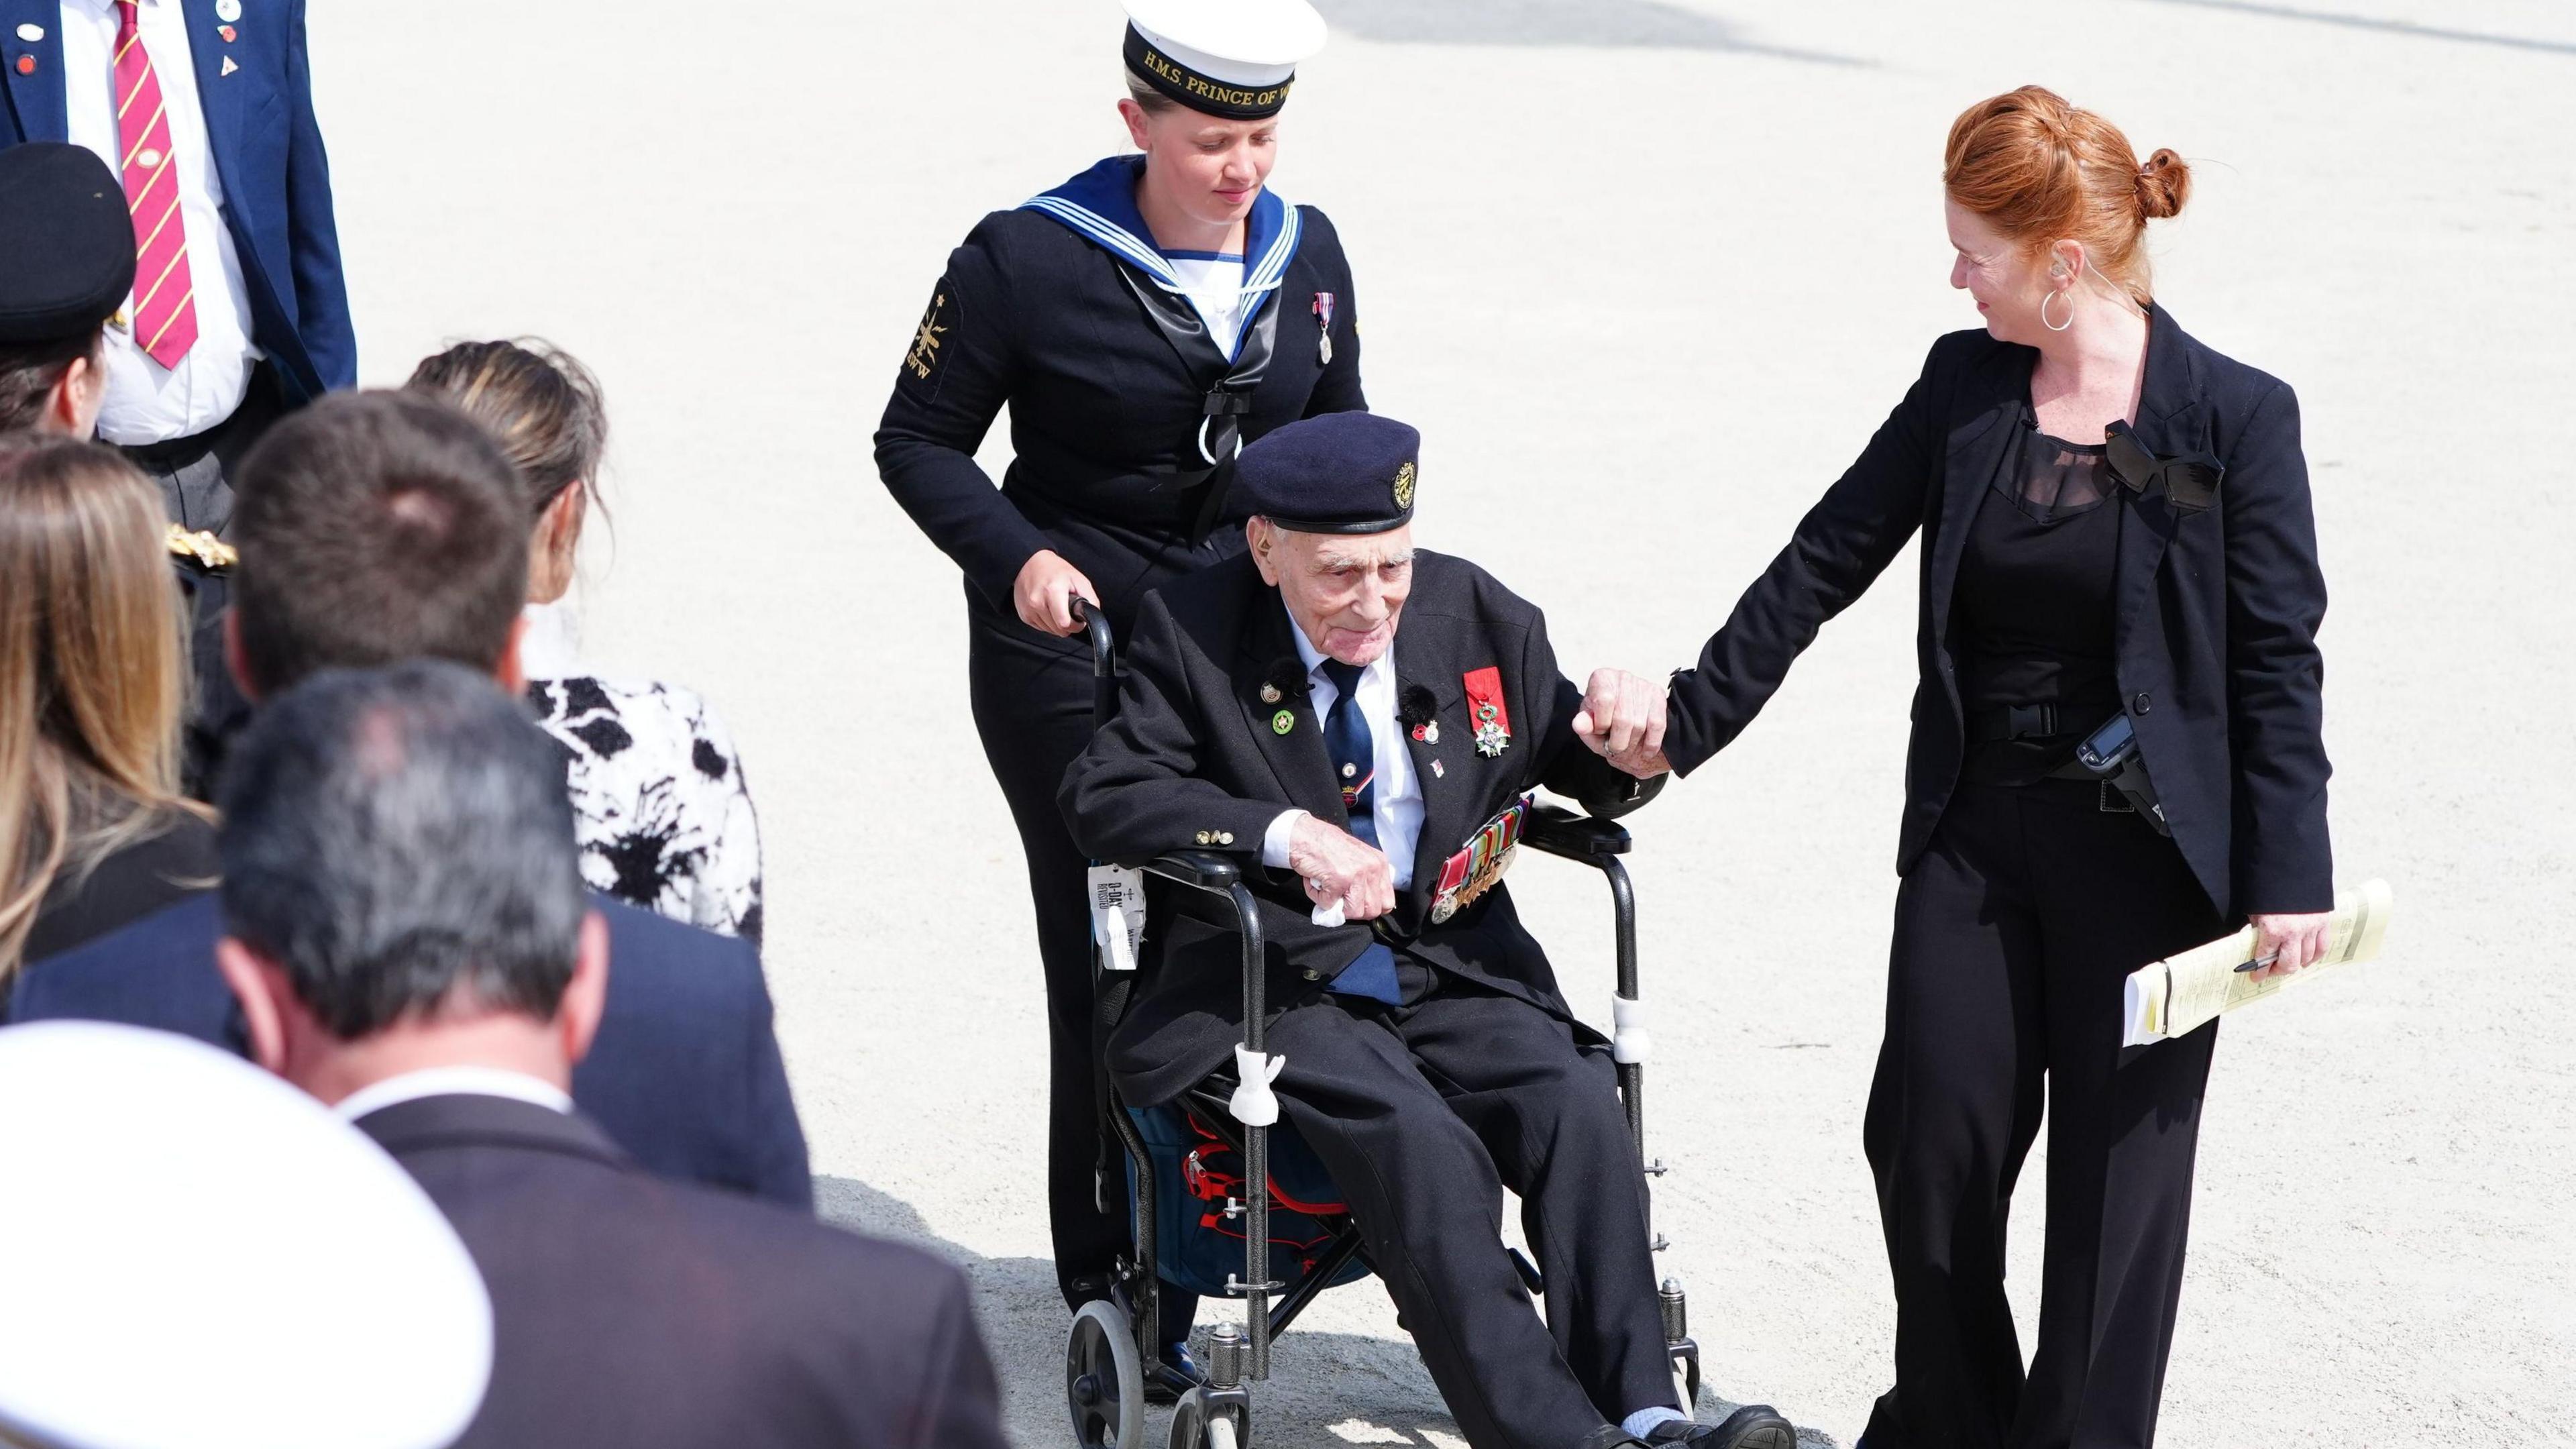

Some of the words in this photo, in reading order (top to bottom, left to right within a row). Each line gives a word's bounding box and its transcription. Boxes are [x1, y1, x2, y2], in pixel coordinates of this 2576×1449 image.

[1186, 76, 1254, 106] PRINCE
[1257, 89, 1278, 106] OF
[1279, 83, 1291, 99] W
[1097, 883, 1109, 910] REVISITED
